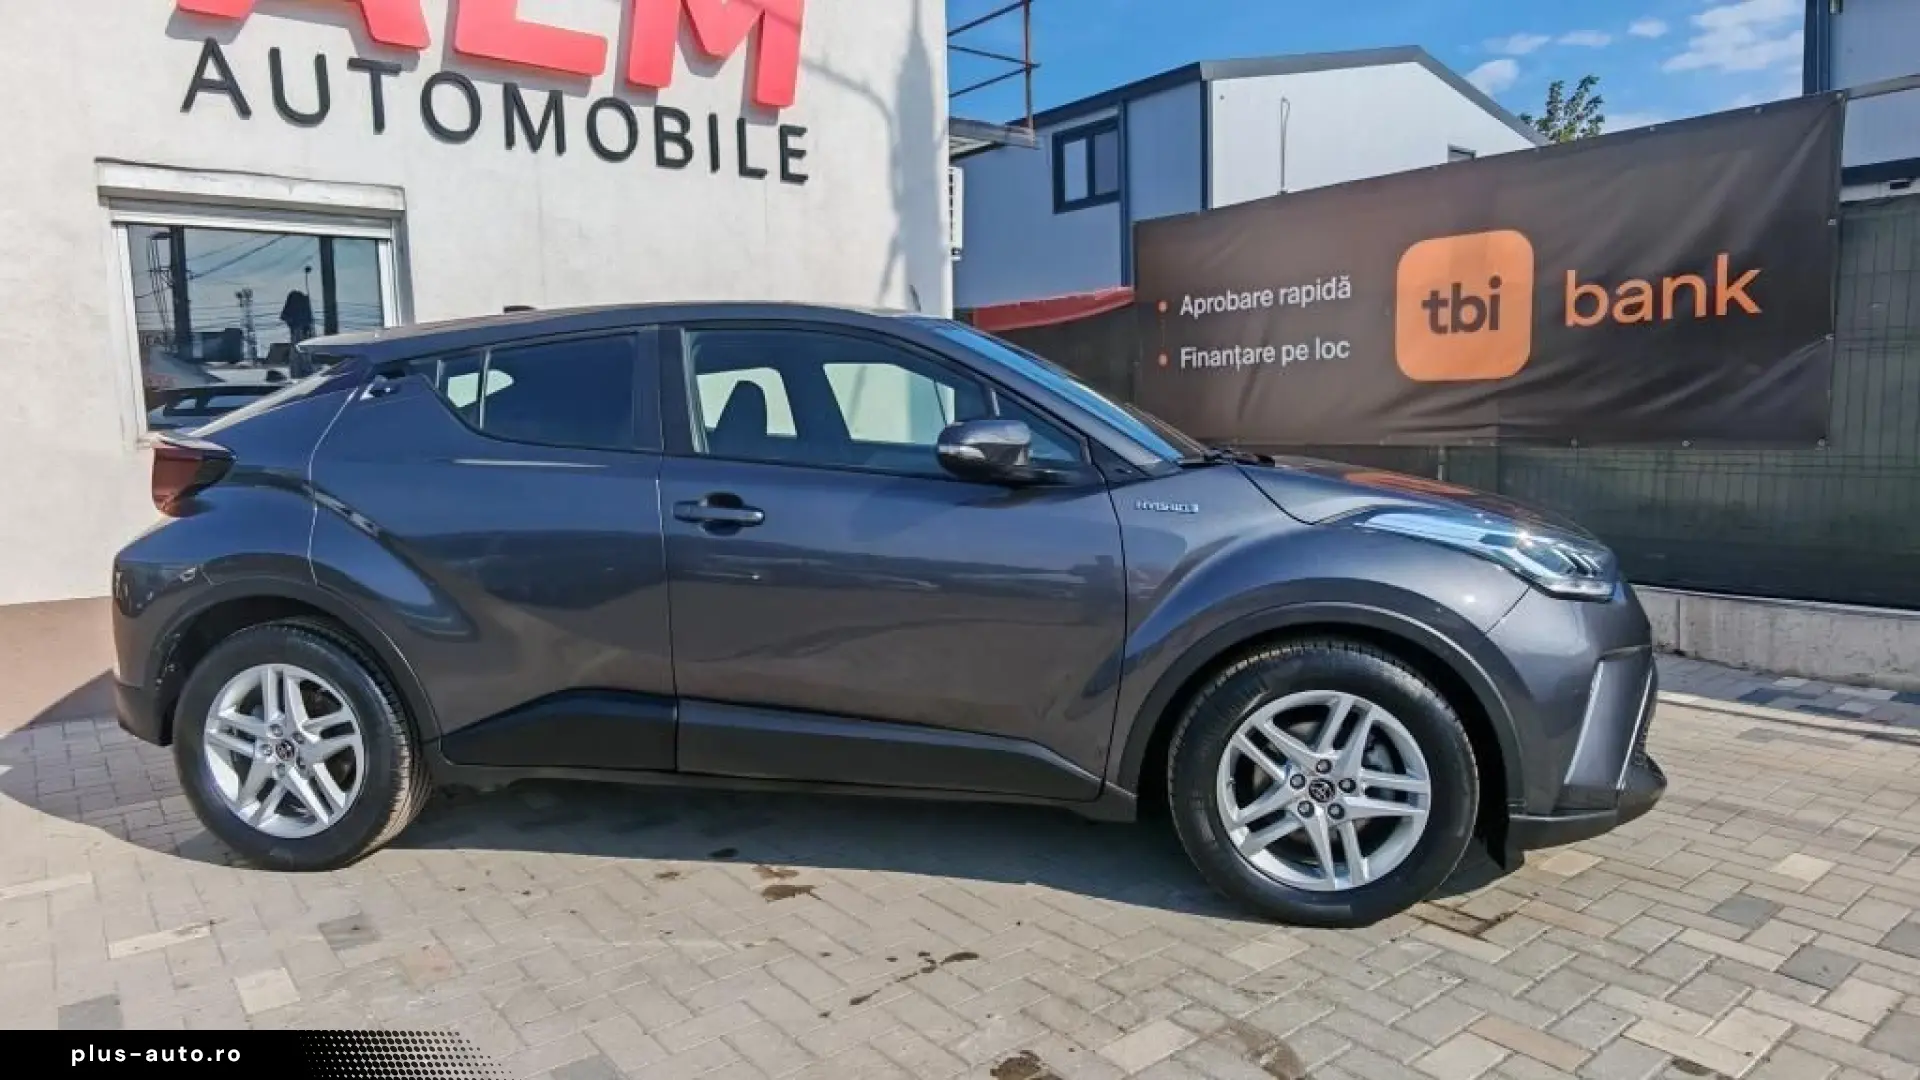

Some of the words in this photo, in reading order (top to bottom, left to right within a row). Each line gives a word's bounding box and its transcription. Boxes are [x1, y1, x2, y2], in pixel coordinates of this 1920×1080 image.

[182, 38, 809, 185] AUTOMOBILE
[1180, 287, 1275, 318] Aprobare
[1279, 275, 1352, 307] rapidă
[1421, 275, 1503, 335] tbi
[1565, 253, 1762, 327] bank
[1281, 342, 1310, 367] pe
[1314, 336, 1351, 361] loc
